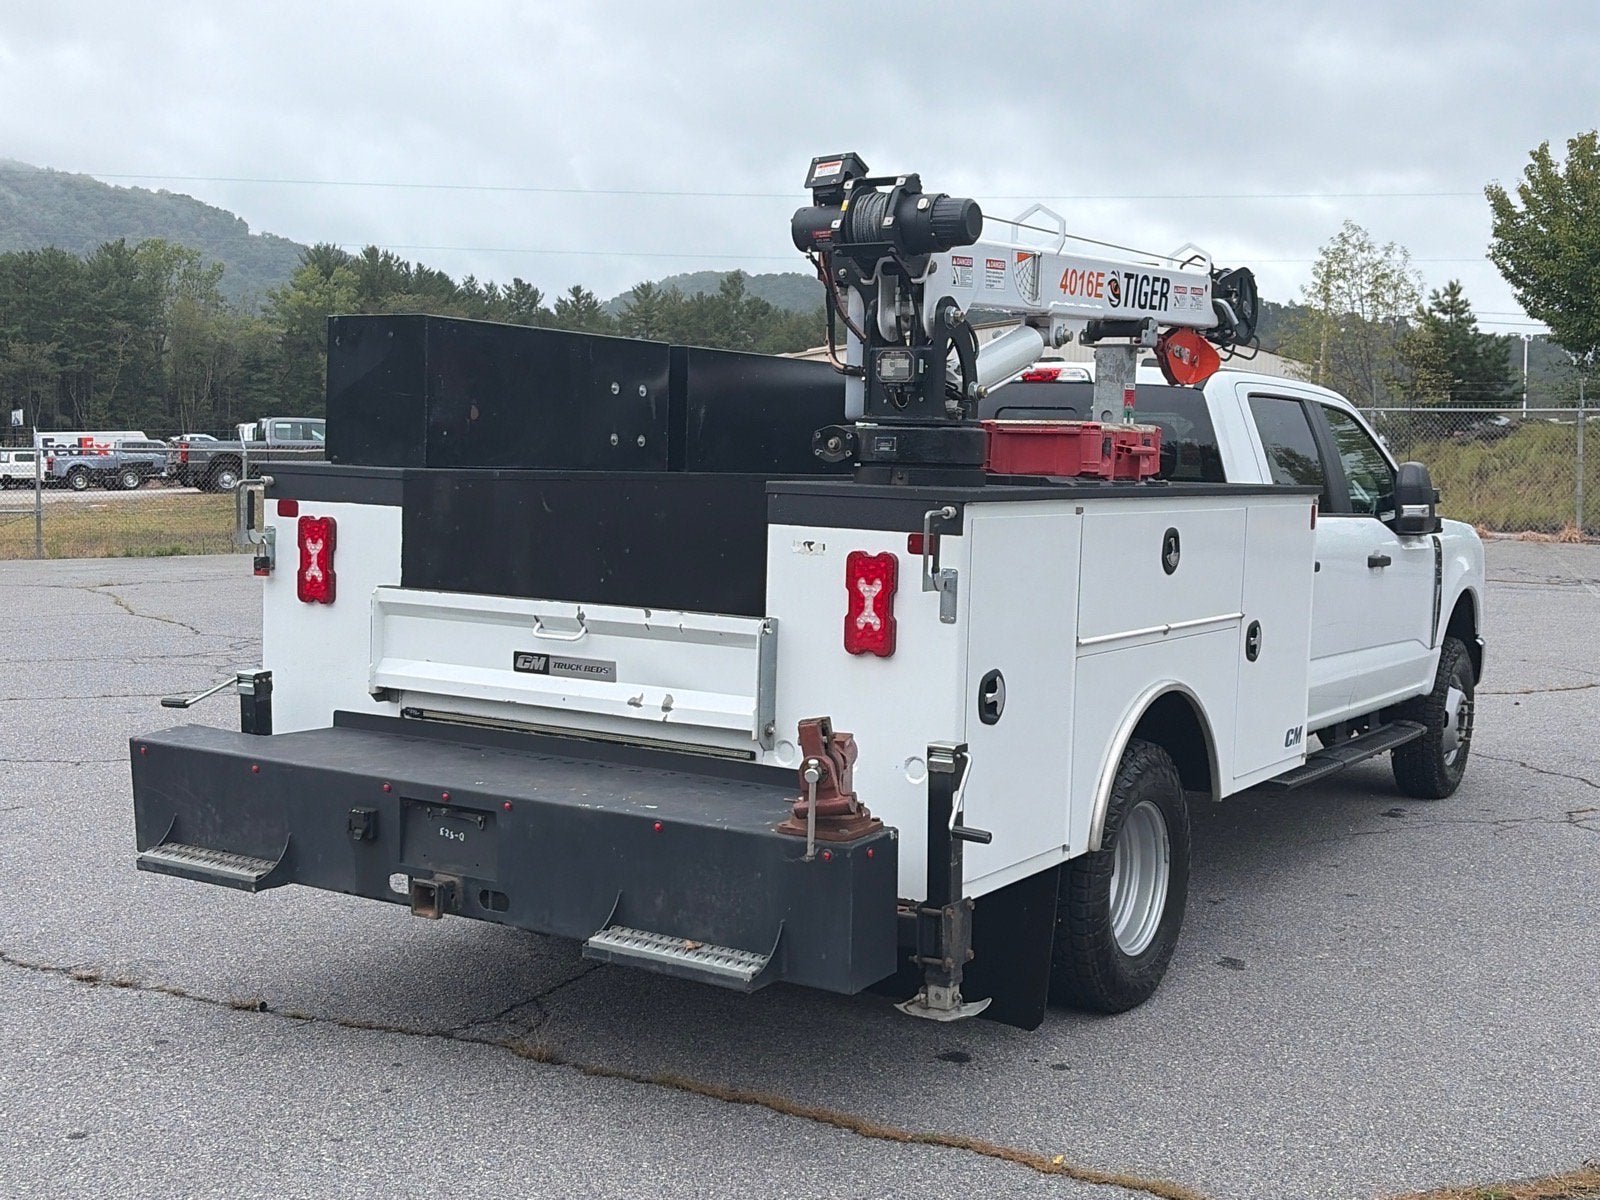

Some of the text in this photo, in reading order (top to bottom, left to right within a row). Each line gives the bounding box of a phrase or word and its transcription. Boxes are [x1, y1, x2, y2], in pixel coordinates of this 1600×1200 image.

[1060, 268, 1170, 311] 4016E TIGER
[42, 437, 110, 457] FedEx
[516, 654, 546, 671] CM
[553, 661, 582, 672] TRUCK
[1285, 725, 1303, 747] CM
